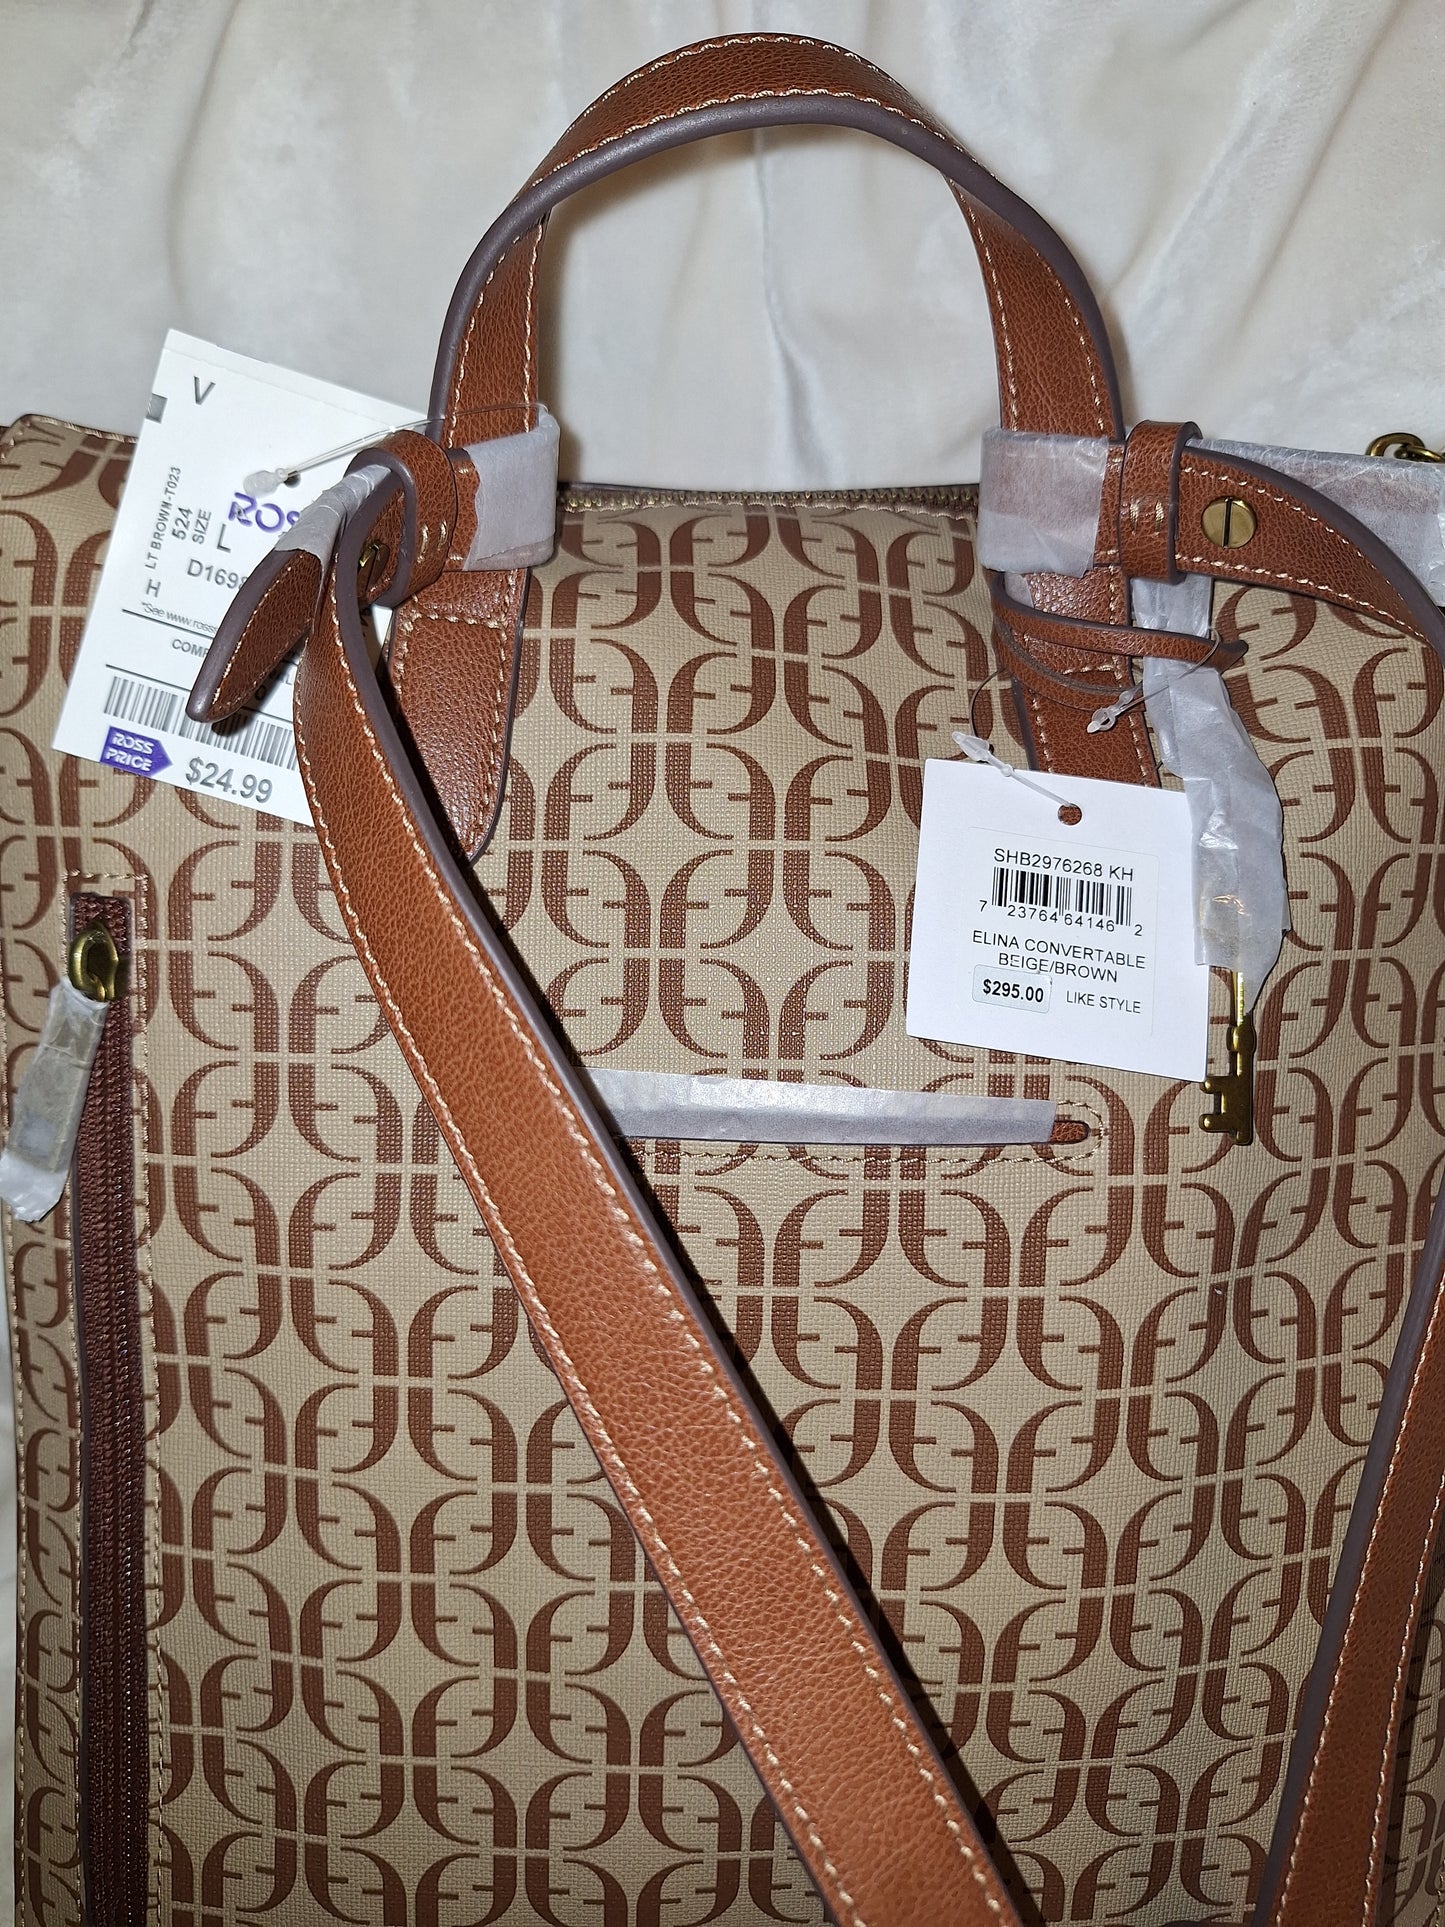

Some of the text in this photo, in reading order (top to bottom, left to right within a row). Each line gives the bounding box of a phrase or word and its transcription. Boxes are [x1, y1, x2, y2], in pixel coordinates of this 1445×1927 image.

[193, 375, 216, 405] V
[145, 466, 182, 570] LT BROWN-T023
[172, 507, 193, 540] 524
[192, 509, 212, 545] SIZE
[216, 523, 231, 553] L
[146, 578, 161, 598] H
[111, 733, 155, 755] ROSS
[104, 747, 154, 773] PRICE
[185, 756, 273, 803] $24.99
[993, 848, 1134, 882] SHB2976268 KH
[979, 900, 1143, 936] 7 23764 64146 2
[973, 930, 1146, 969] ELINA CONVERTABLE
[998, 953, 1118, 983] BEIGE/BROWN
[982, 978, 1044, 1003] $295.00
[1066, 991, 1141, 1014] LIKE STYLE
